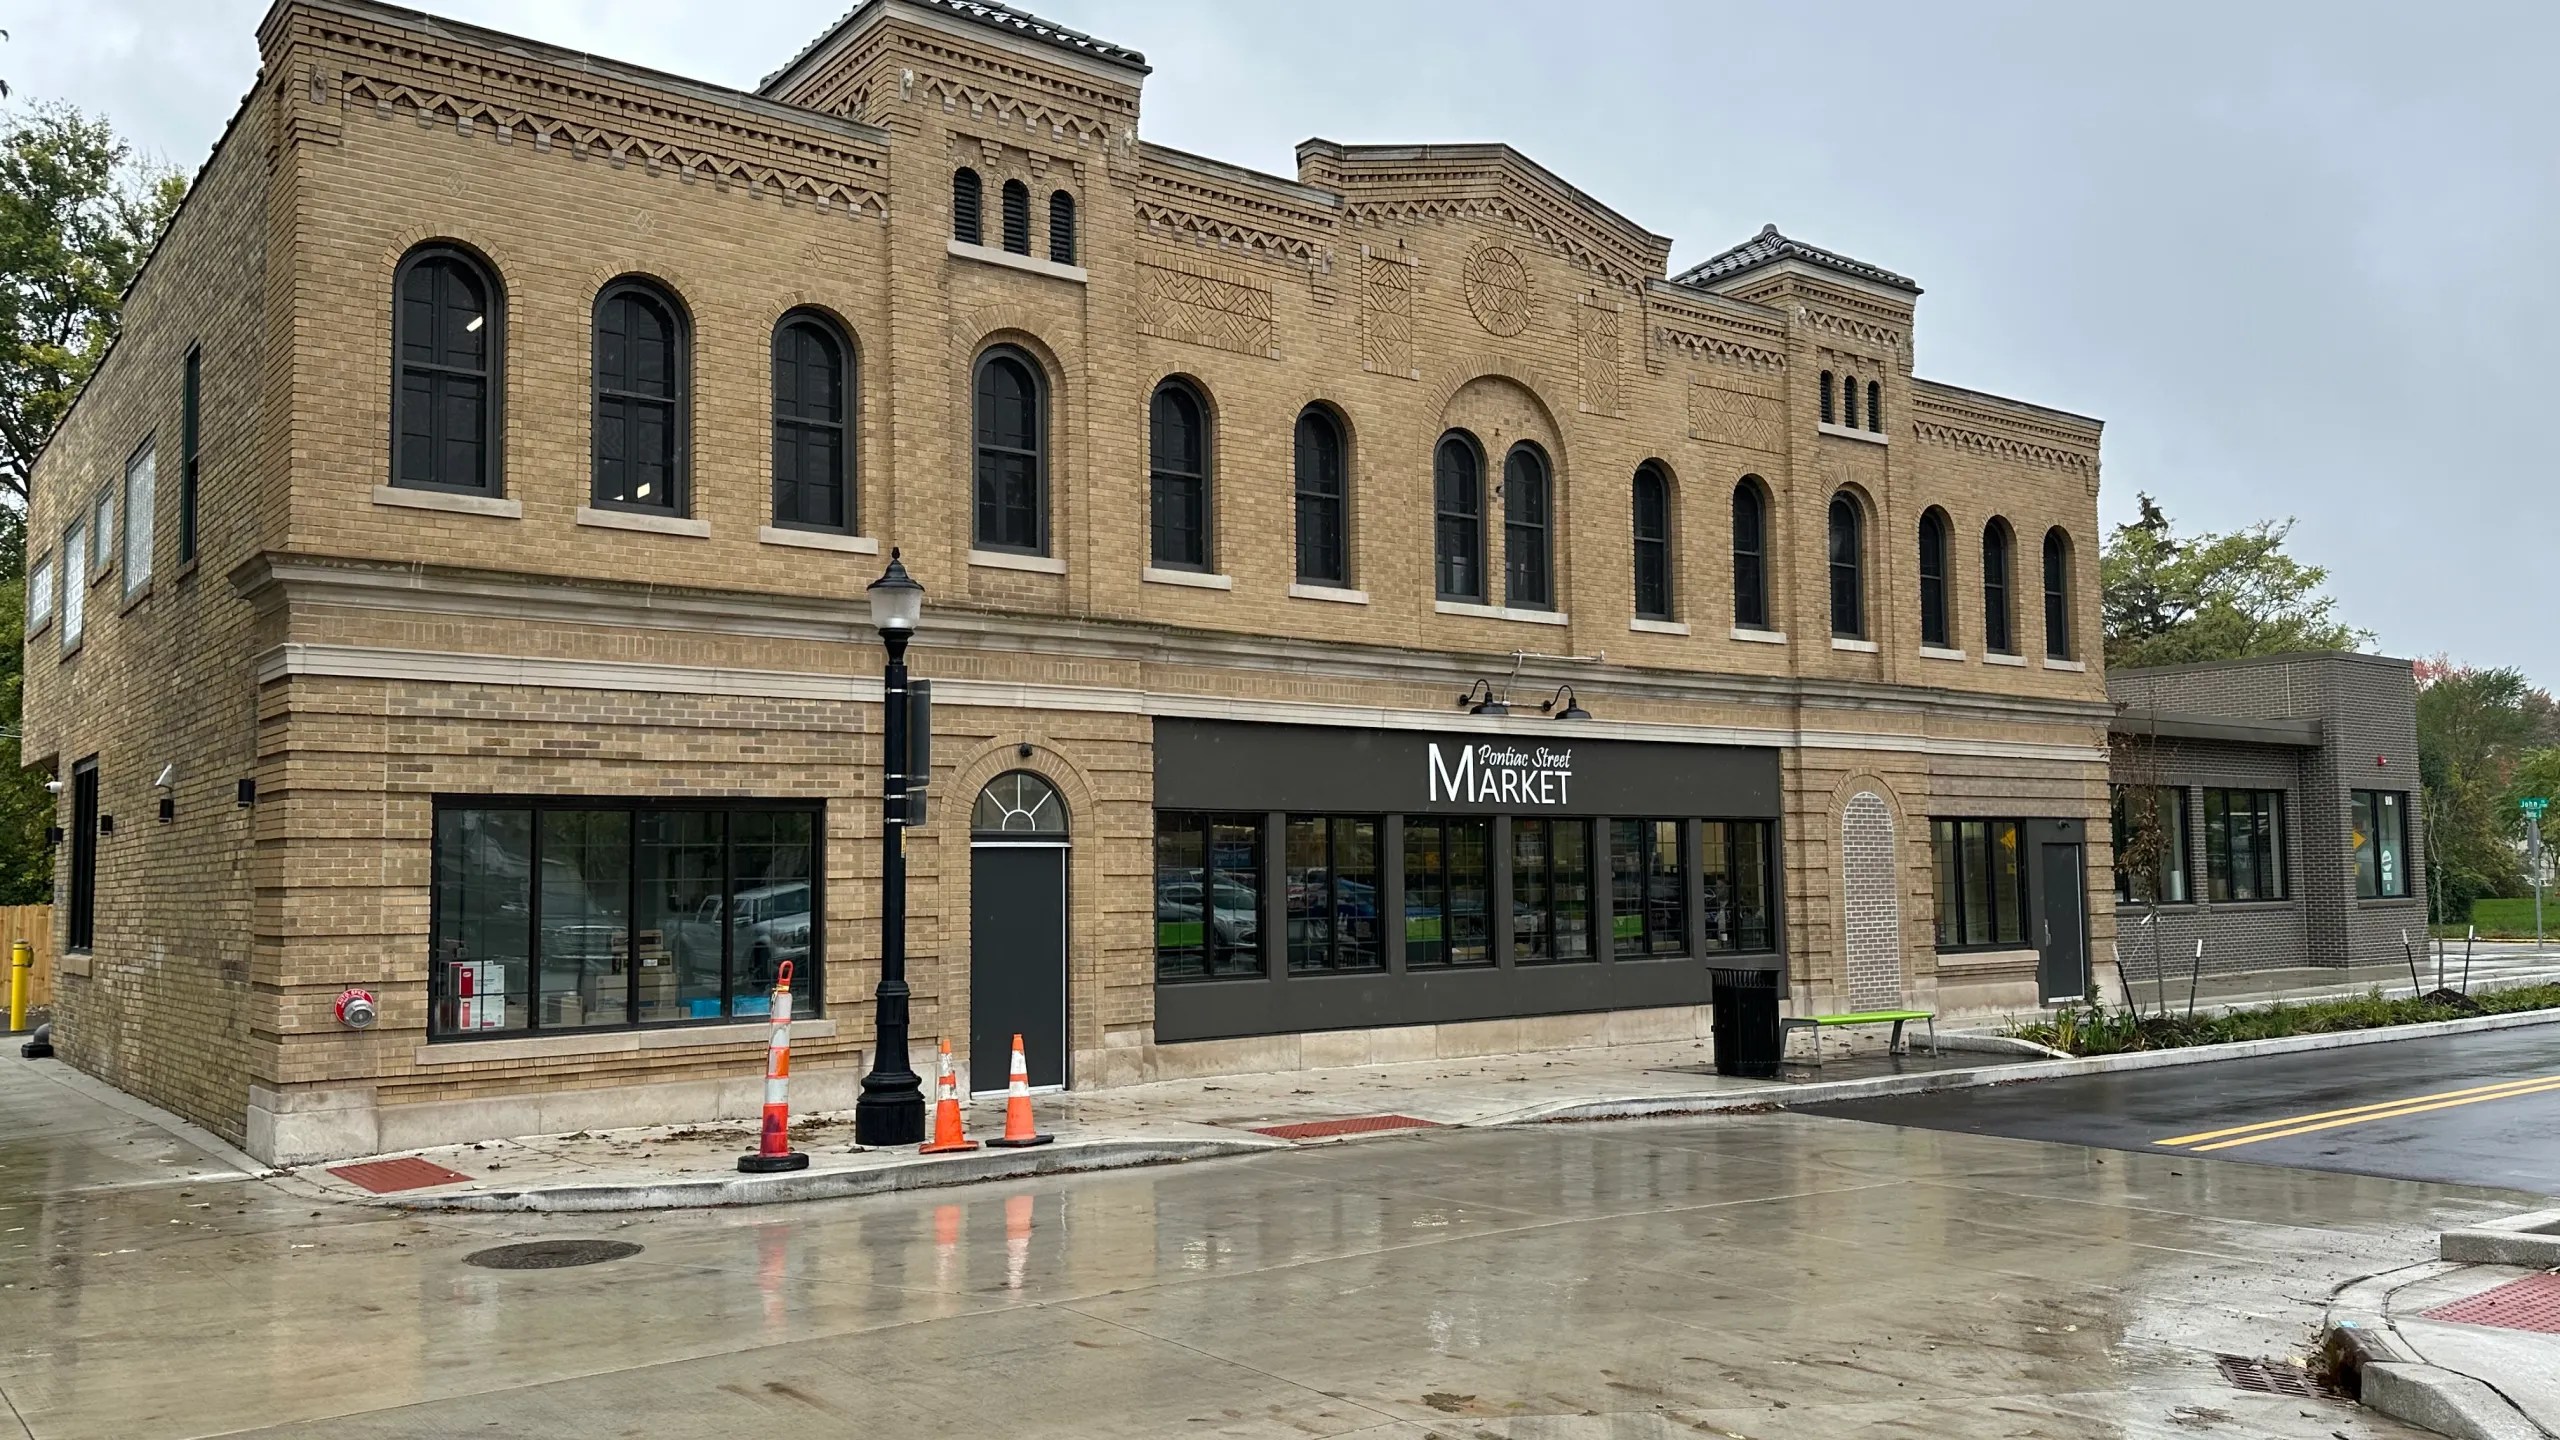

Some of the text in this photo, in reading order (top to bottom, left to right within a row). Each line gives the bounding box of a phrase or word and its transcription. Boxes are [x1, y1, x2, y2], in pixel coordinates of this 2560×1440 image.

[1478, 744, 1572, 768] Pontiac Street
[1428, 742, 1573, 805] MARKET
[2520, 800, 2538, 808] John
